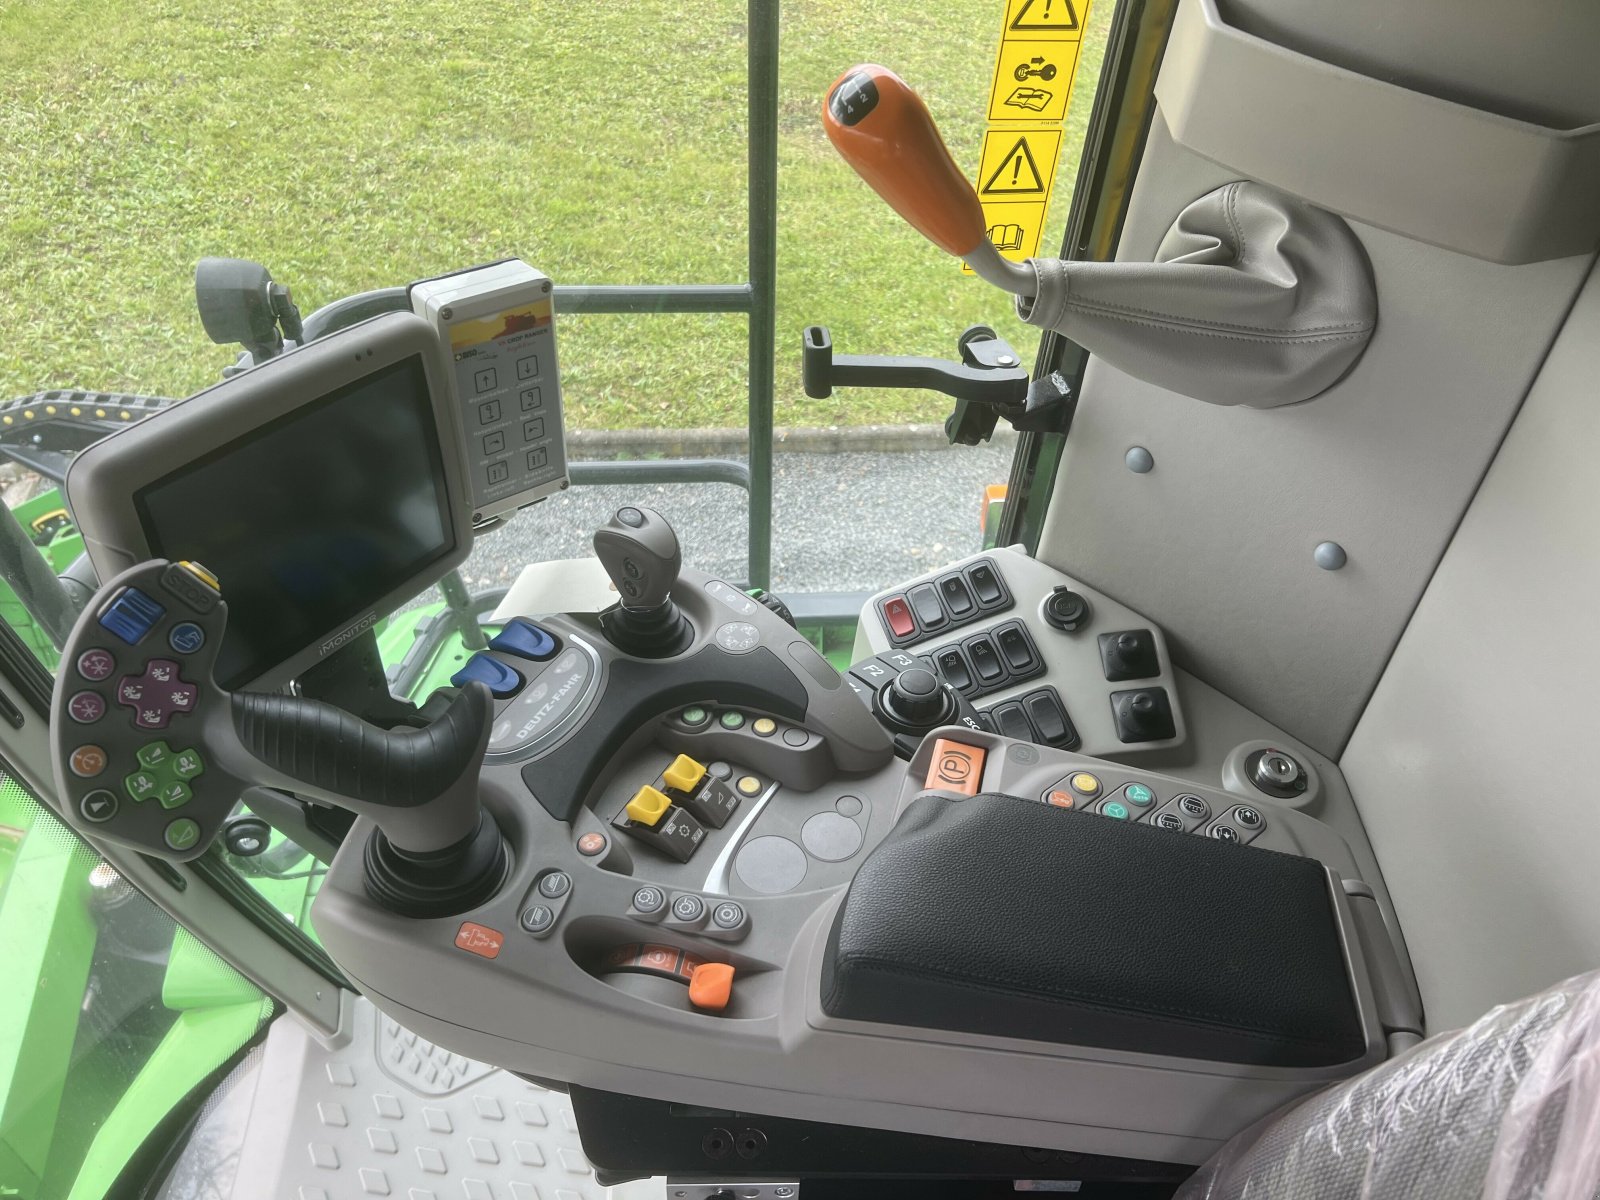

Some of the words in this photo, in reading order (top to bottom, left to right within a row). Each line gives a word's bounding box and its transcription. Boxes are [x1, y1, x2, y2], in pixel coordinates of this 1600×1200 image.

[168, 574, 210, 609] STOP
[891, 654, 913, 666] F3
[862, 664, 885, 677] F2
[516, 673, 582, 739] DEUTZ-FAHR
[962, 716, 981, 730] ESC
